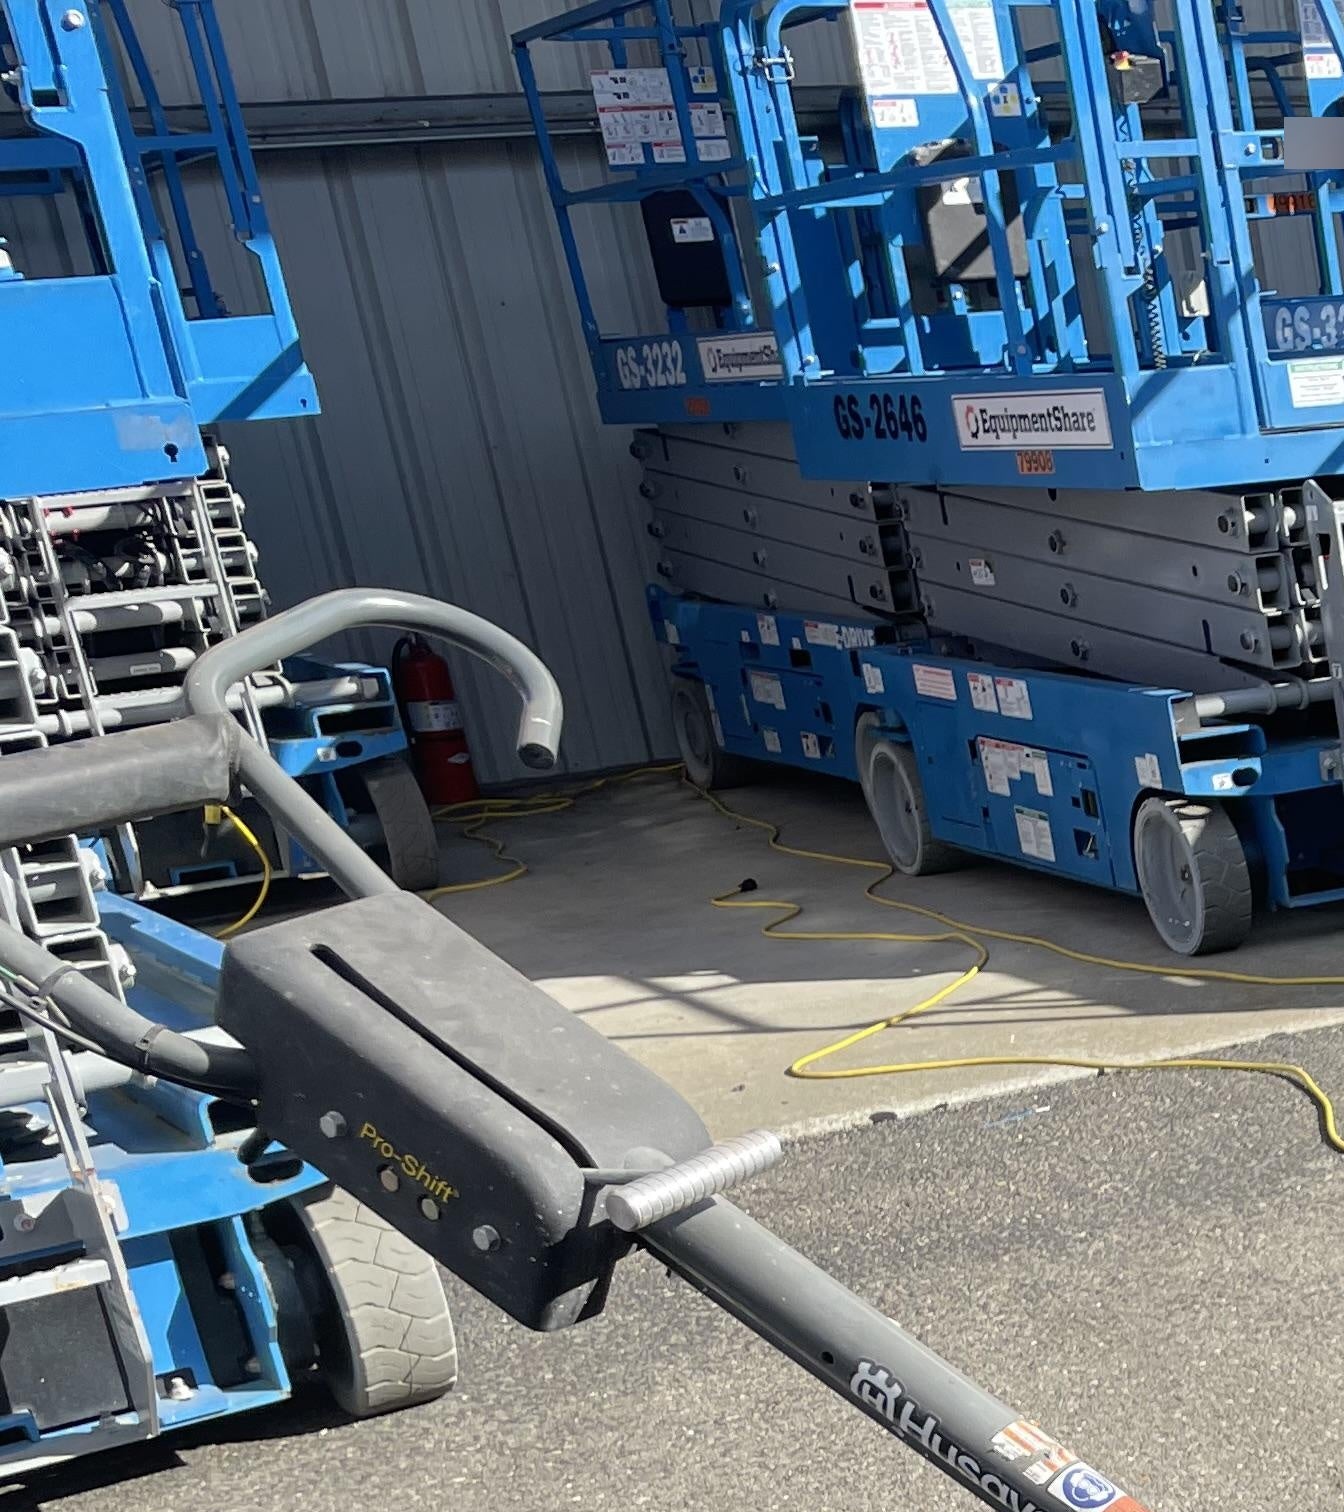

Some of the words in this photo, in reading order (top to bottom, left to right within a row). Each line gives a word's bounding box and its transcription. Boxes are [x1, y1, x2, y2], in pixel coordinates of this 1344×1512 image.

[616, 340, 687, 389] GS-3232
[833, 393, 928, 443] GS-2646
[980, 405, 1096, 441] EquipmentShare
[360, 1122, 453, 1203] Pro-Shift
